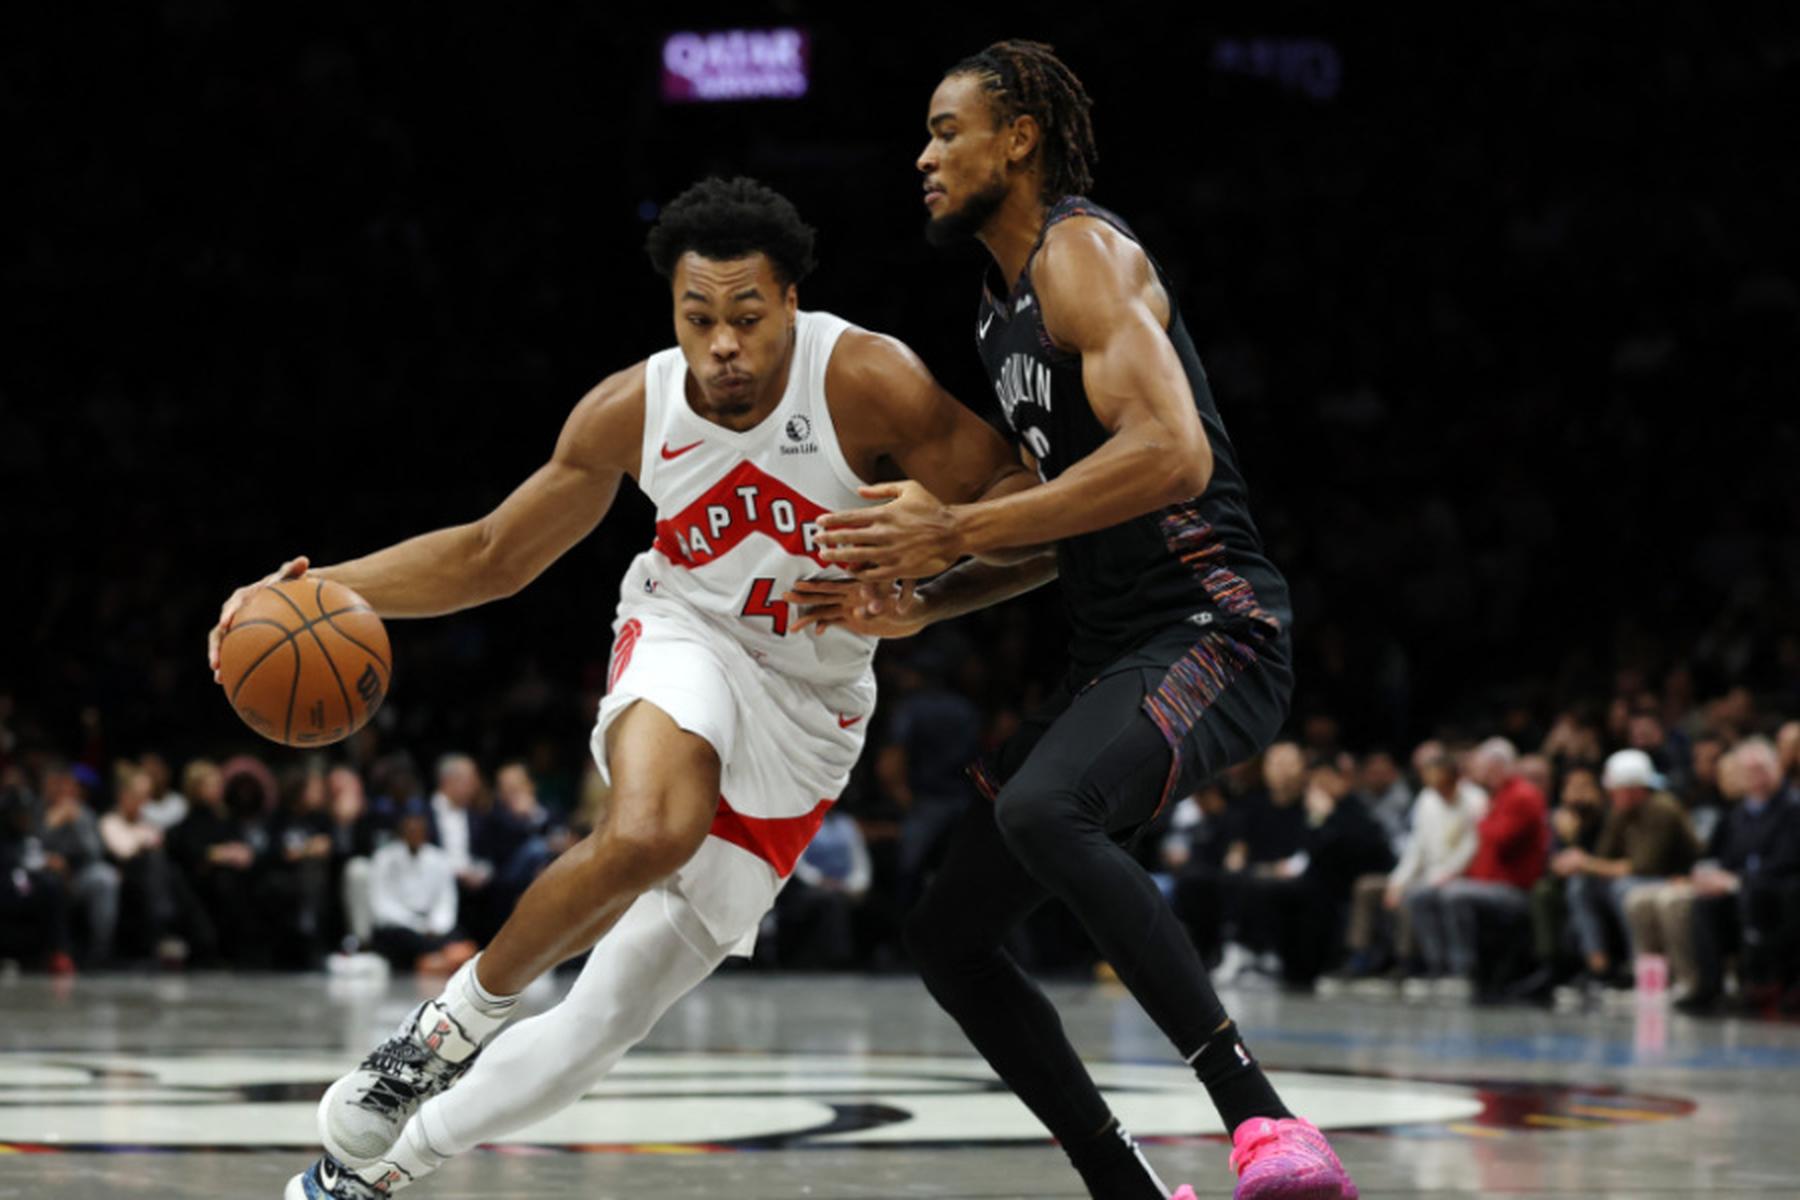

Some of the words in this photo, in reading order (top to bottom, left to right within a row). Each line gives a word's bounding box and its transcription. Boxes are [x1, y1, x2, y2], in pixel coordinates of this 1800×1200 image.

[780, 444, 799, 457] Sun
[800, 442, 819, 455] Life
[740, 577, 790, 638] 4
